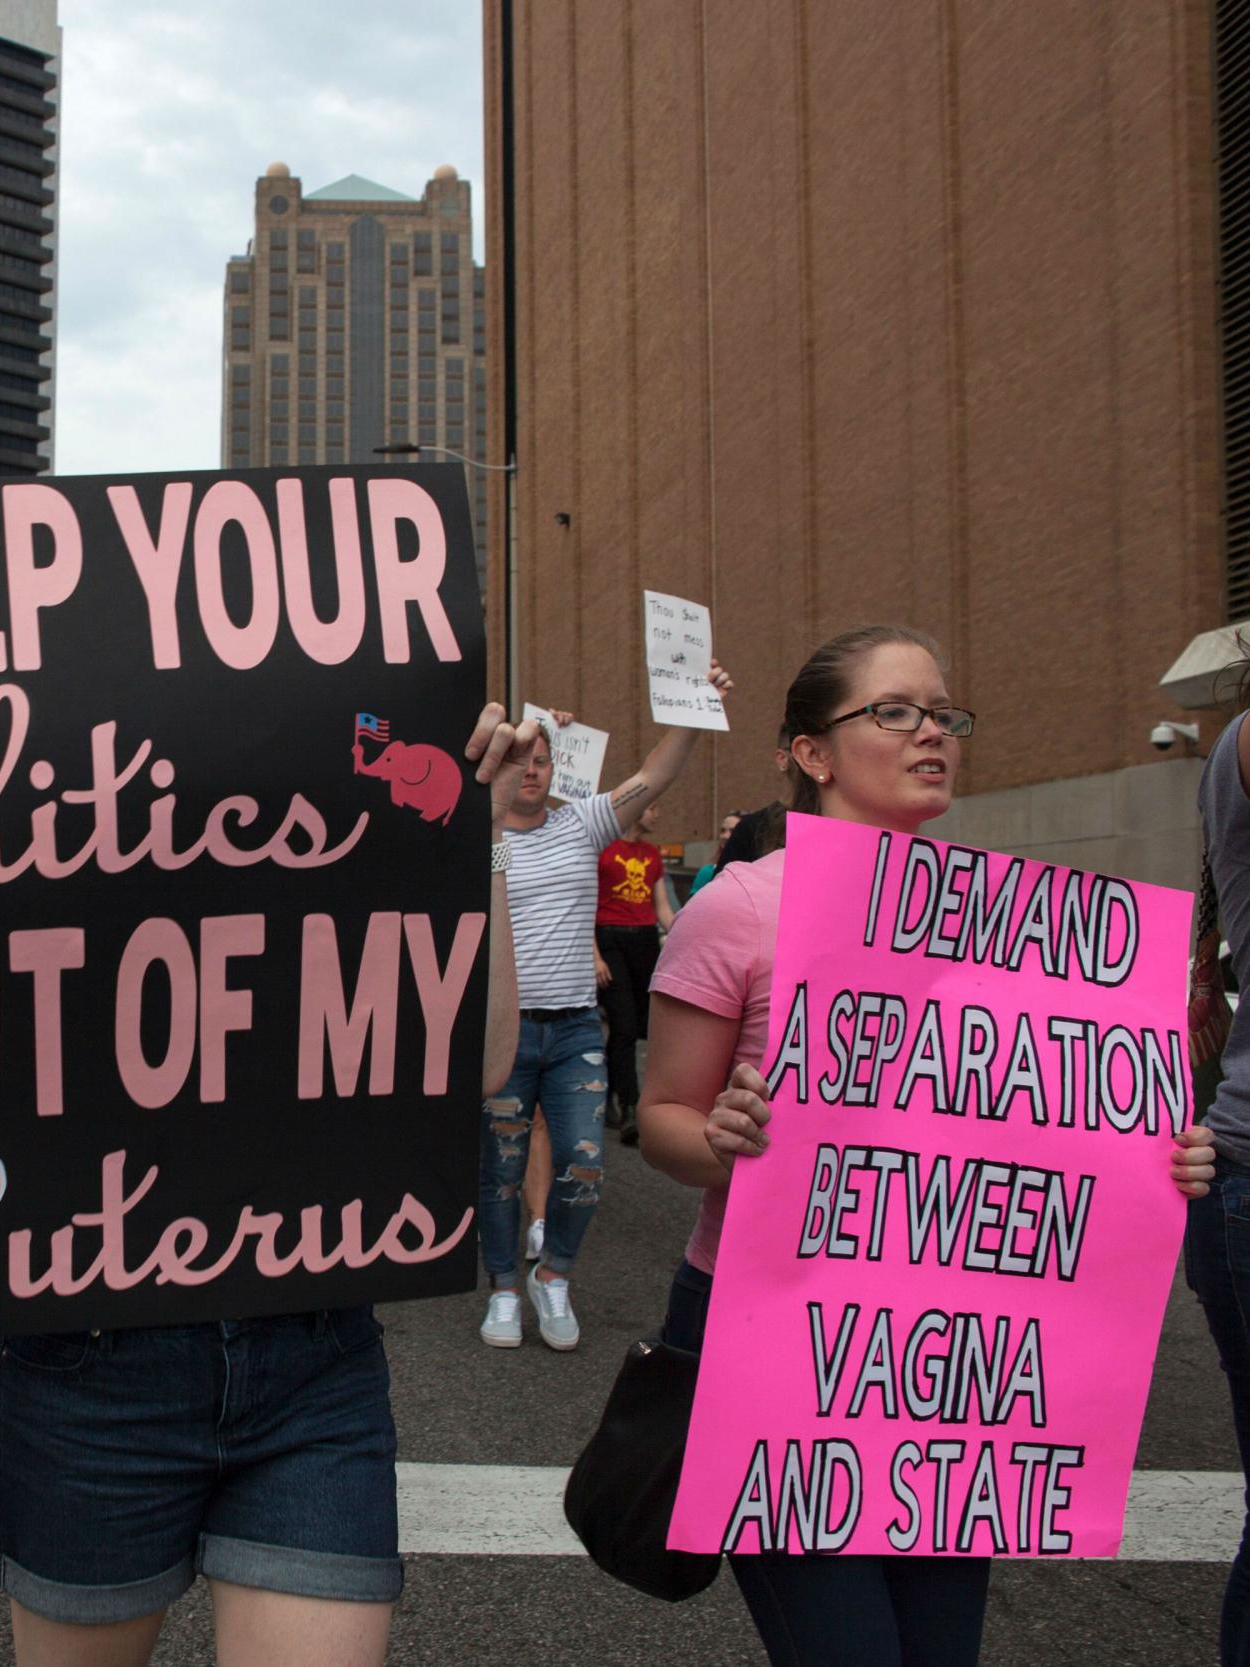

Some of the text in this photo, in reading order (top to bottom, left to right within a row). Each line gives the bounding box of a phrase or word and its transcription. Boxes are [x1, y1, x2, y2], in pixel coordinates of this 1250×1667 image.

[106, 477, 462, 671] YOUR
[653, 627, 672, 640] not
[864, 830, 1140, 987] I DEMAND
[114, 913, 265, 1109] OF
[297, 911, 487, 1100] MY
[766, 980, 1187, 1137] A SEPARATION
[7, 1149, 474, 1298] uterus
[797, 1143, 1097, 1282] BETWEEN
[807, 1301, 1047, 1428] VAGINA
[720, 1439, 1085, 1555] AND STATE
